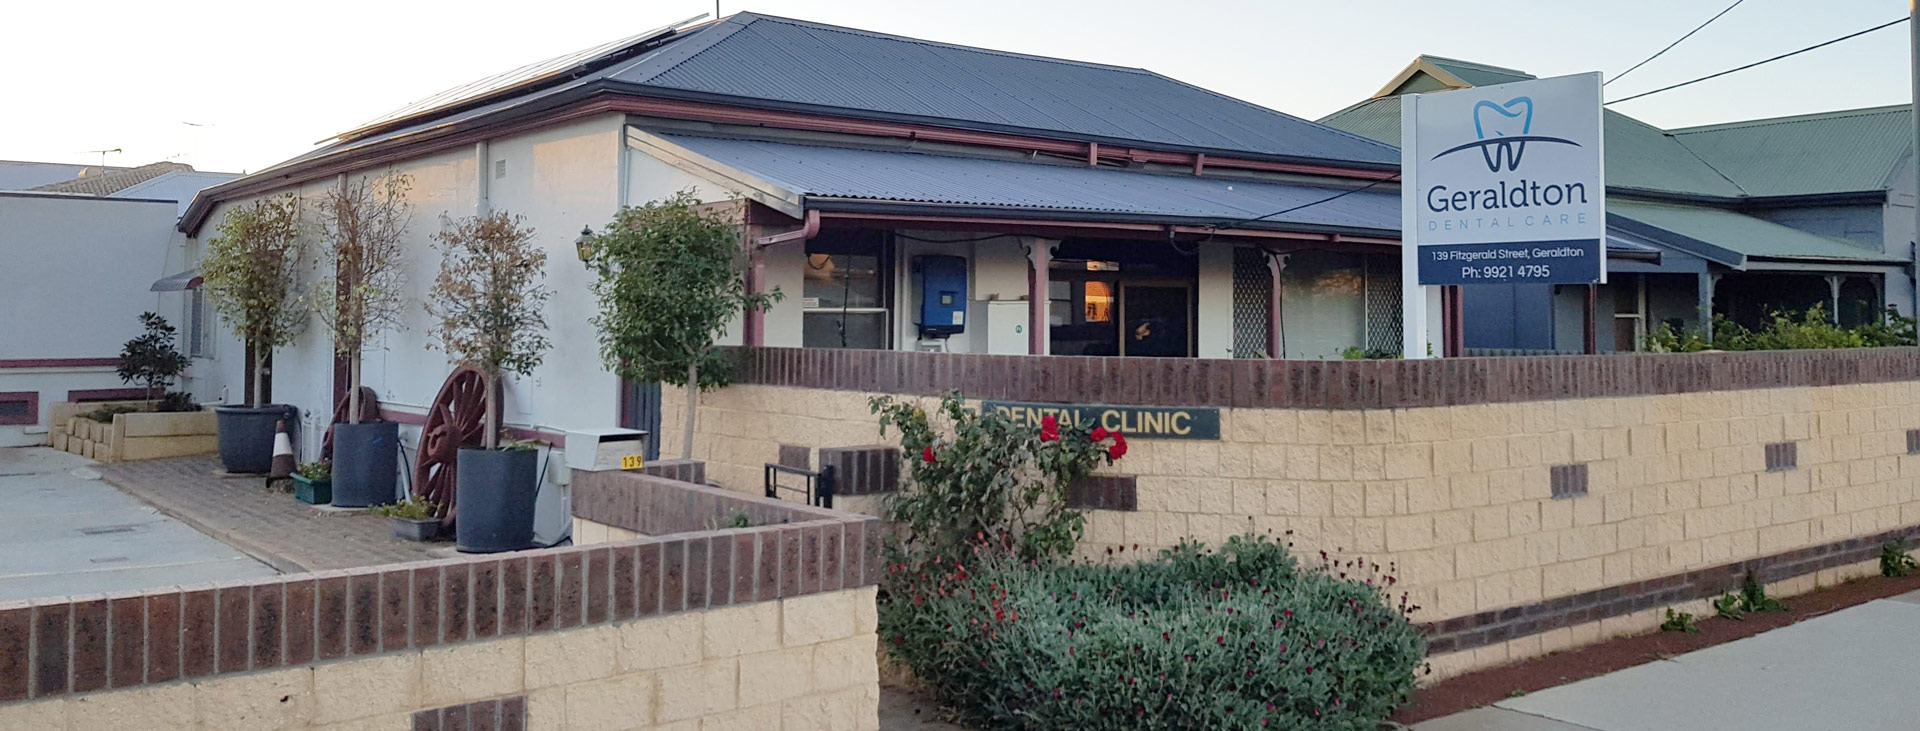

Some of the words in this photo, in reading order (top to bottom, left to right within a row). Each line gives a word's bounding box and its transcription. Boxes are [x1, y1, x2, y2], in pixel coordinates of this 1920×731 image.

[1427, 179, 1588, 213] Geraldton
[1428, 217, 1515, 231] DENTAL
[1524, 212, 1587, 227] CARE
[1432, 251, 1449, 261] 139
[1450, 249, 1497, 262] Fitzgerald
[1498, 248, 1531, 260] Street,
[1532, 247, 1584, 258] Geraldton
[1462, 266, 1482, 279] Ph:
[1483, 265, 1514, 278] 9921
[1517, 264, 1550, 277] 4795
[1101, 409, 1192, 435] CLINIC
[623, 456, 642, 468] 139
